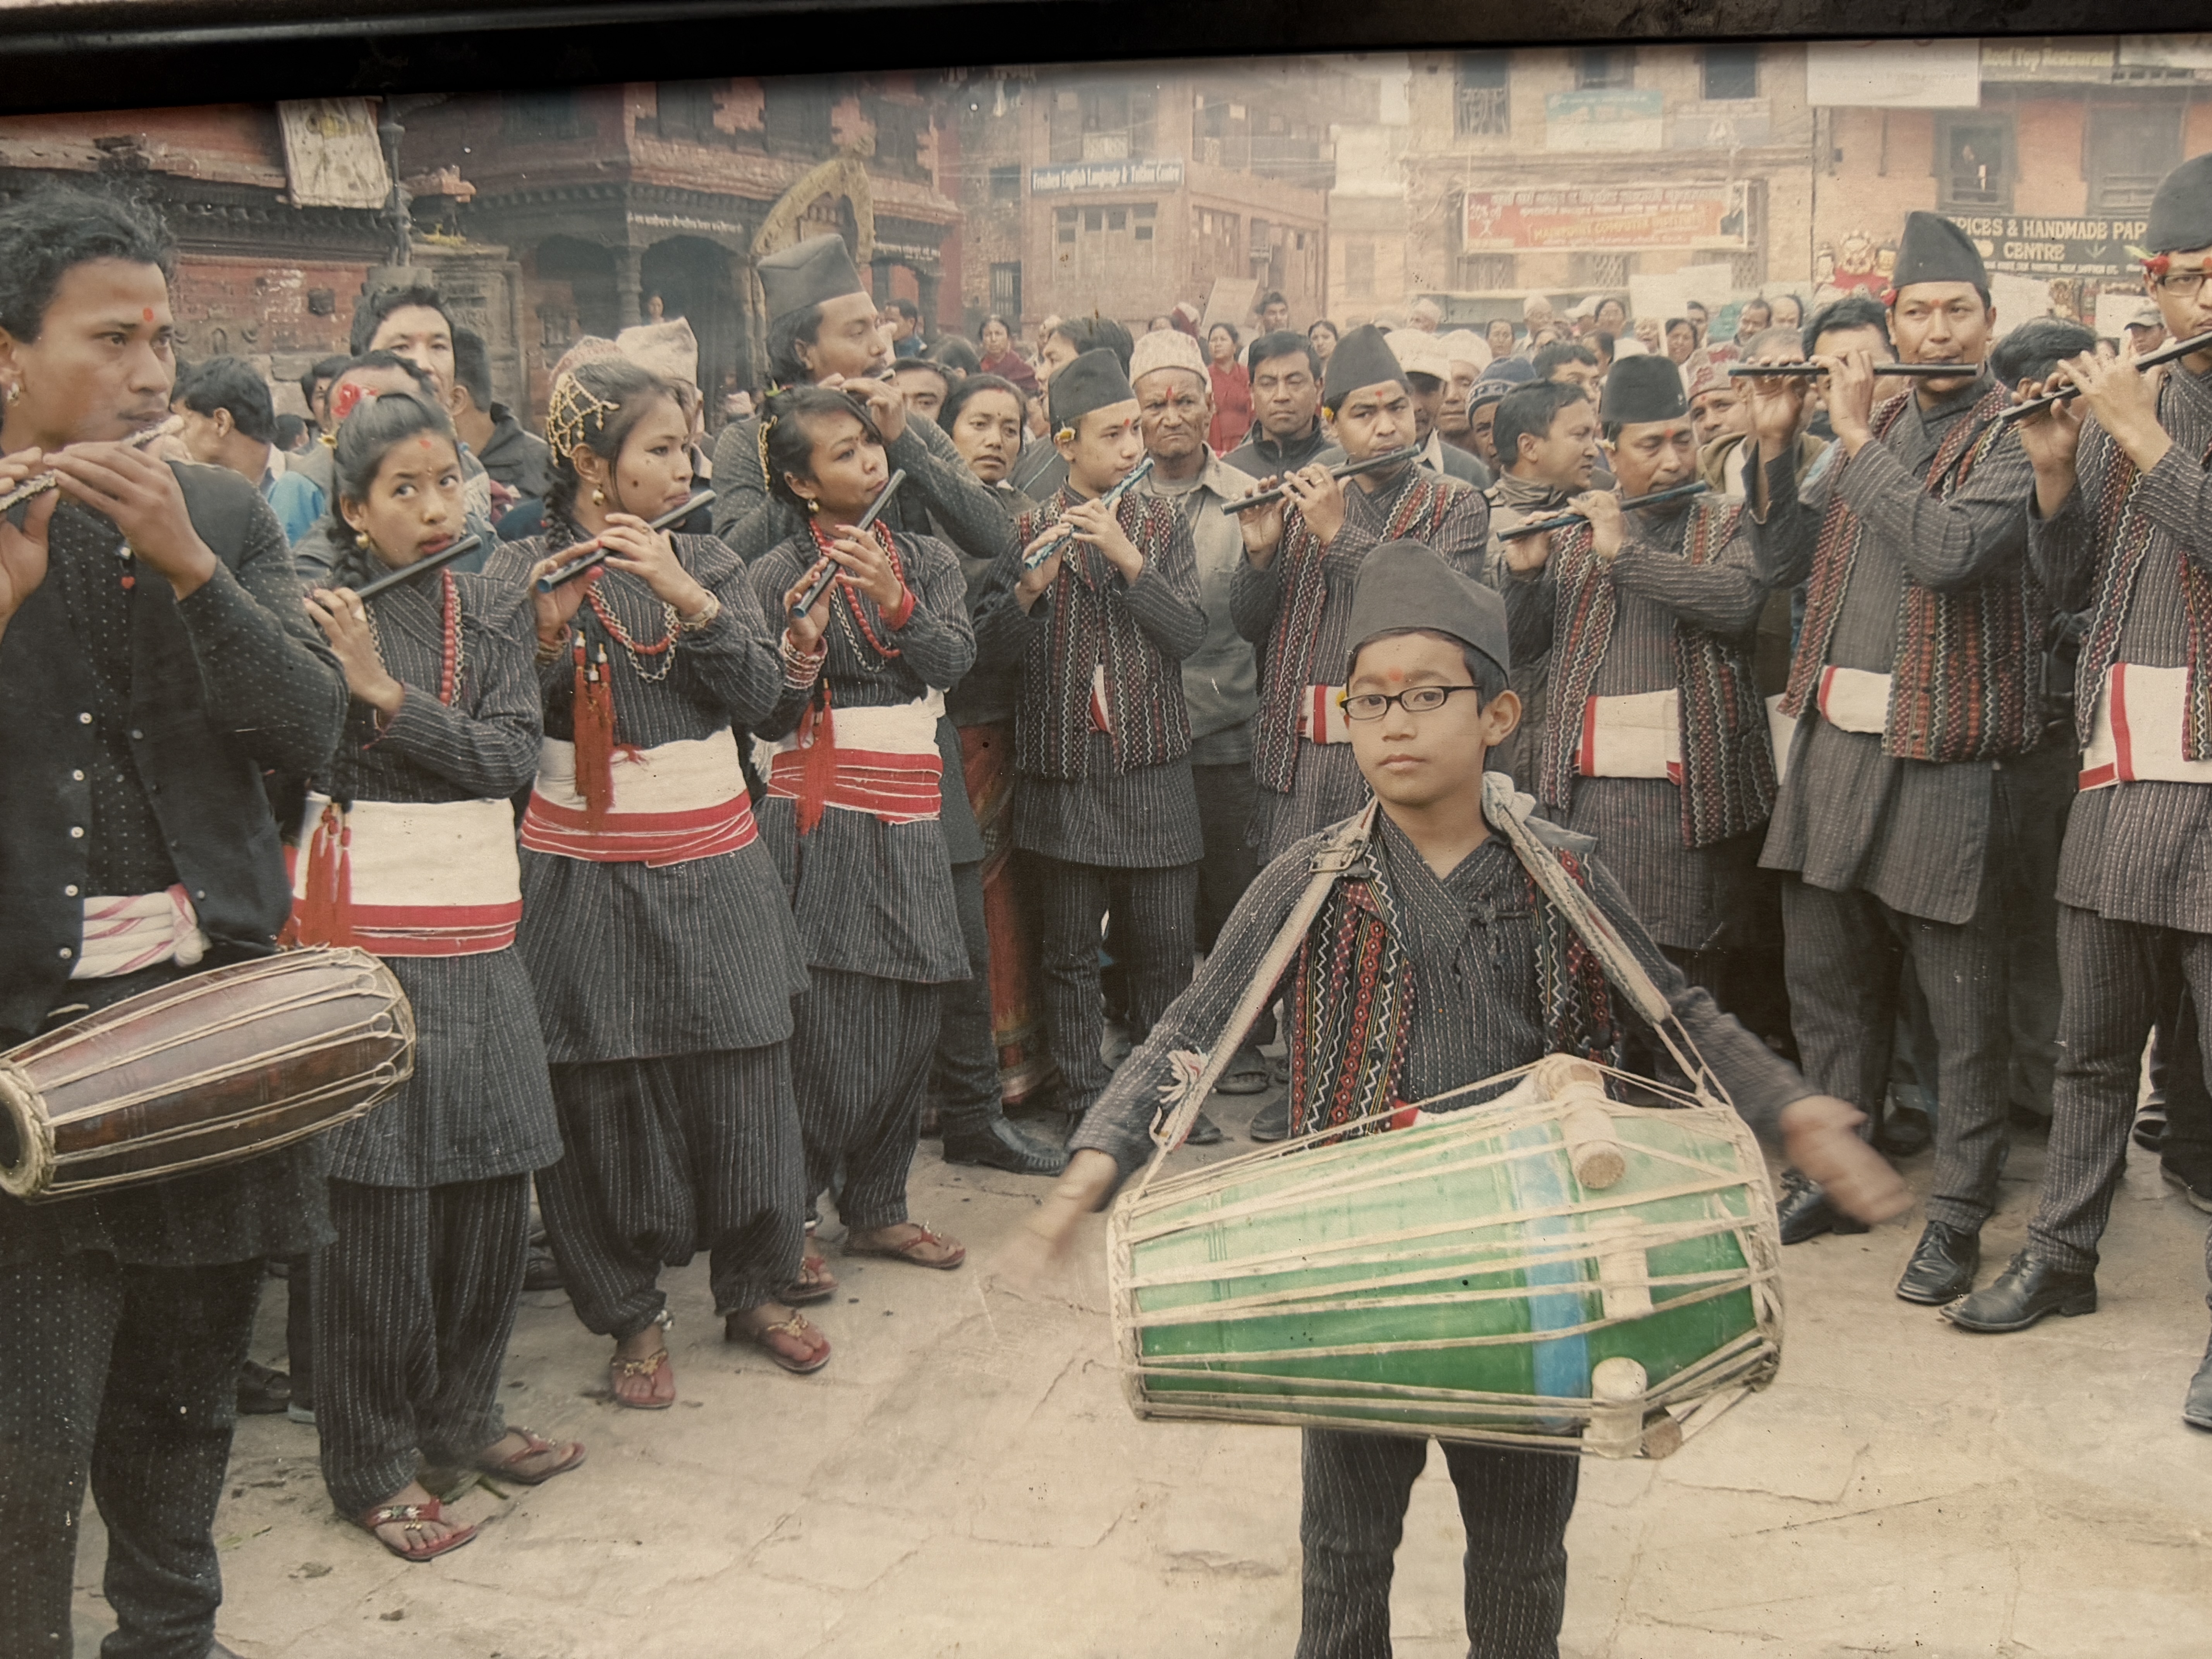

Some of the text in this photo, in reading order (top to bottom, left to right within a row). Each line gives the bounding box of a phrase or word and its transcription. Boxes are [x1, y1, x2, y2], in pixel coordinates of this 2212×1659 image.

[2015, 47, 2040, 71] Top
[2042, 46, 2114, 67] Restaurant
[2007, 219, 2018, 237] &
[2023, 220, 2108, 240] HANDMADE
[2003, 242, 2066, 261] CENTRE
